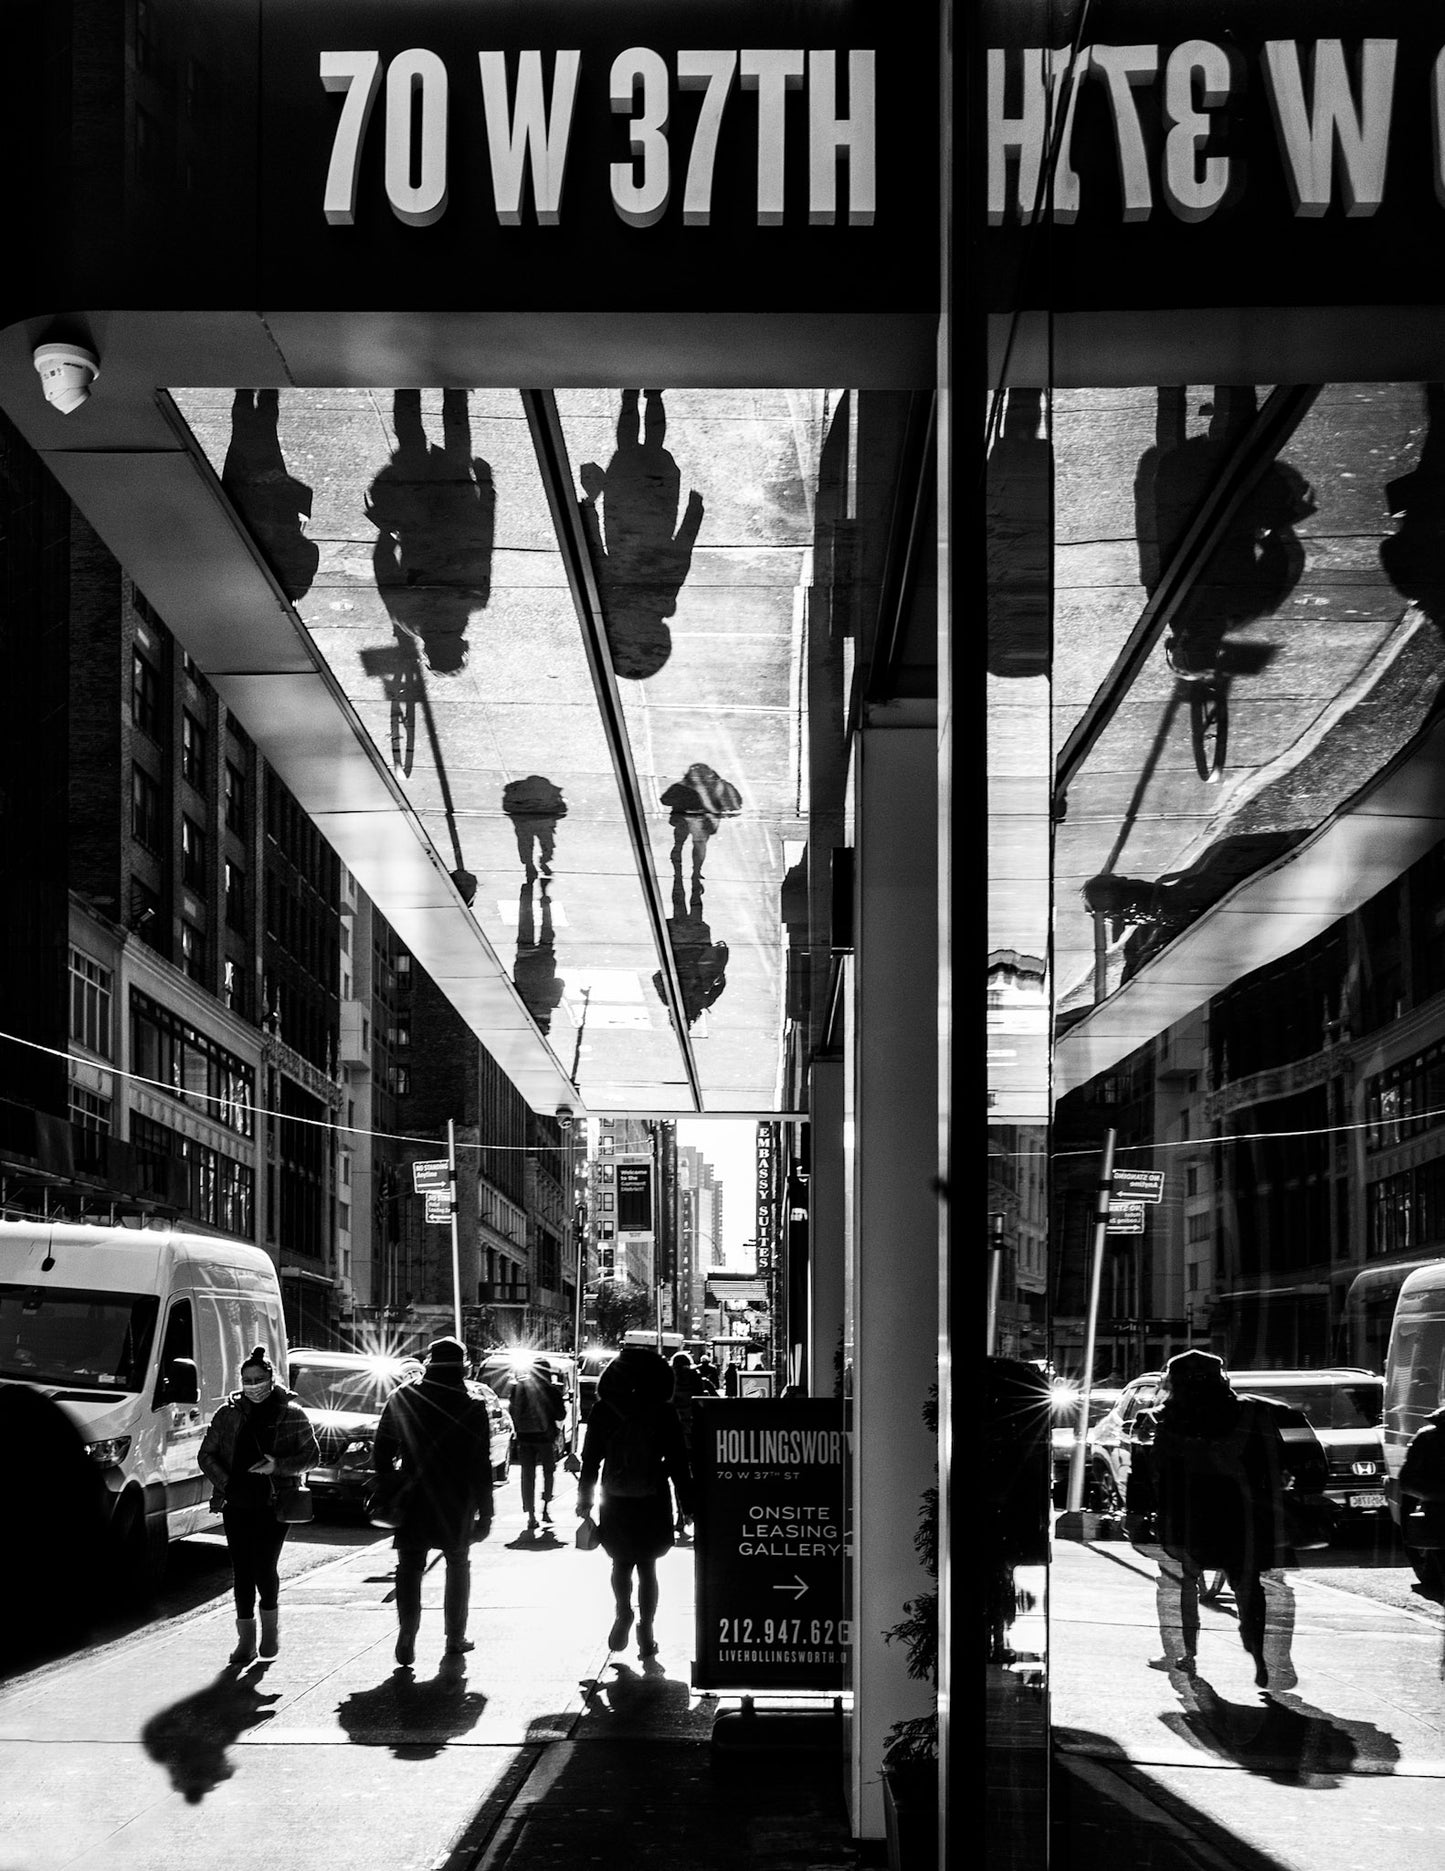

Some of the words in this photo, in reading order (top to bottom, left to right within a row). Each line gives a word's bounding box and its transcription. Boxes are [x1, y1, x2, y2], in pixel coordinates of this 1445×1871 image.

[320, 48, 448, 227] 70
[478, 50, 582, 226] W
[610, 47, 876, 228] 37TH
[757, 1127, 770, 1199] EMBASSY
[758, 1206, 770, 1268] SUITES
[717, 1471, 733, 1480] 70
[737, 1471, 750, 1480] W
[754, 1471, 781, 1480] 37TH
[784, 1471, 800, 1480] ST
[749, 1506, 830, 1520] ONSITE
[742, 1524, 837, 1539] LEASING
[738, 1542, 841, 1556] GALLERY
